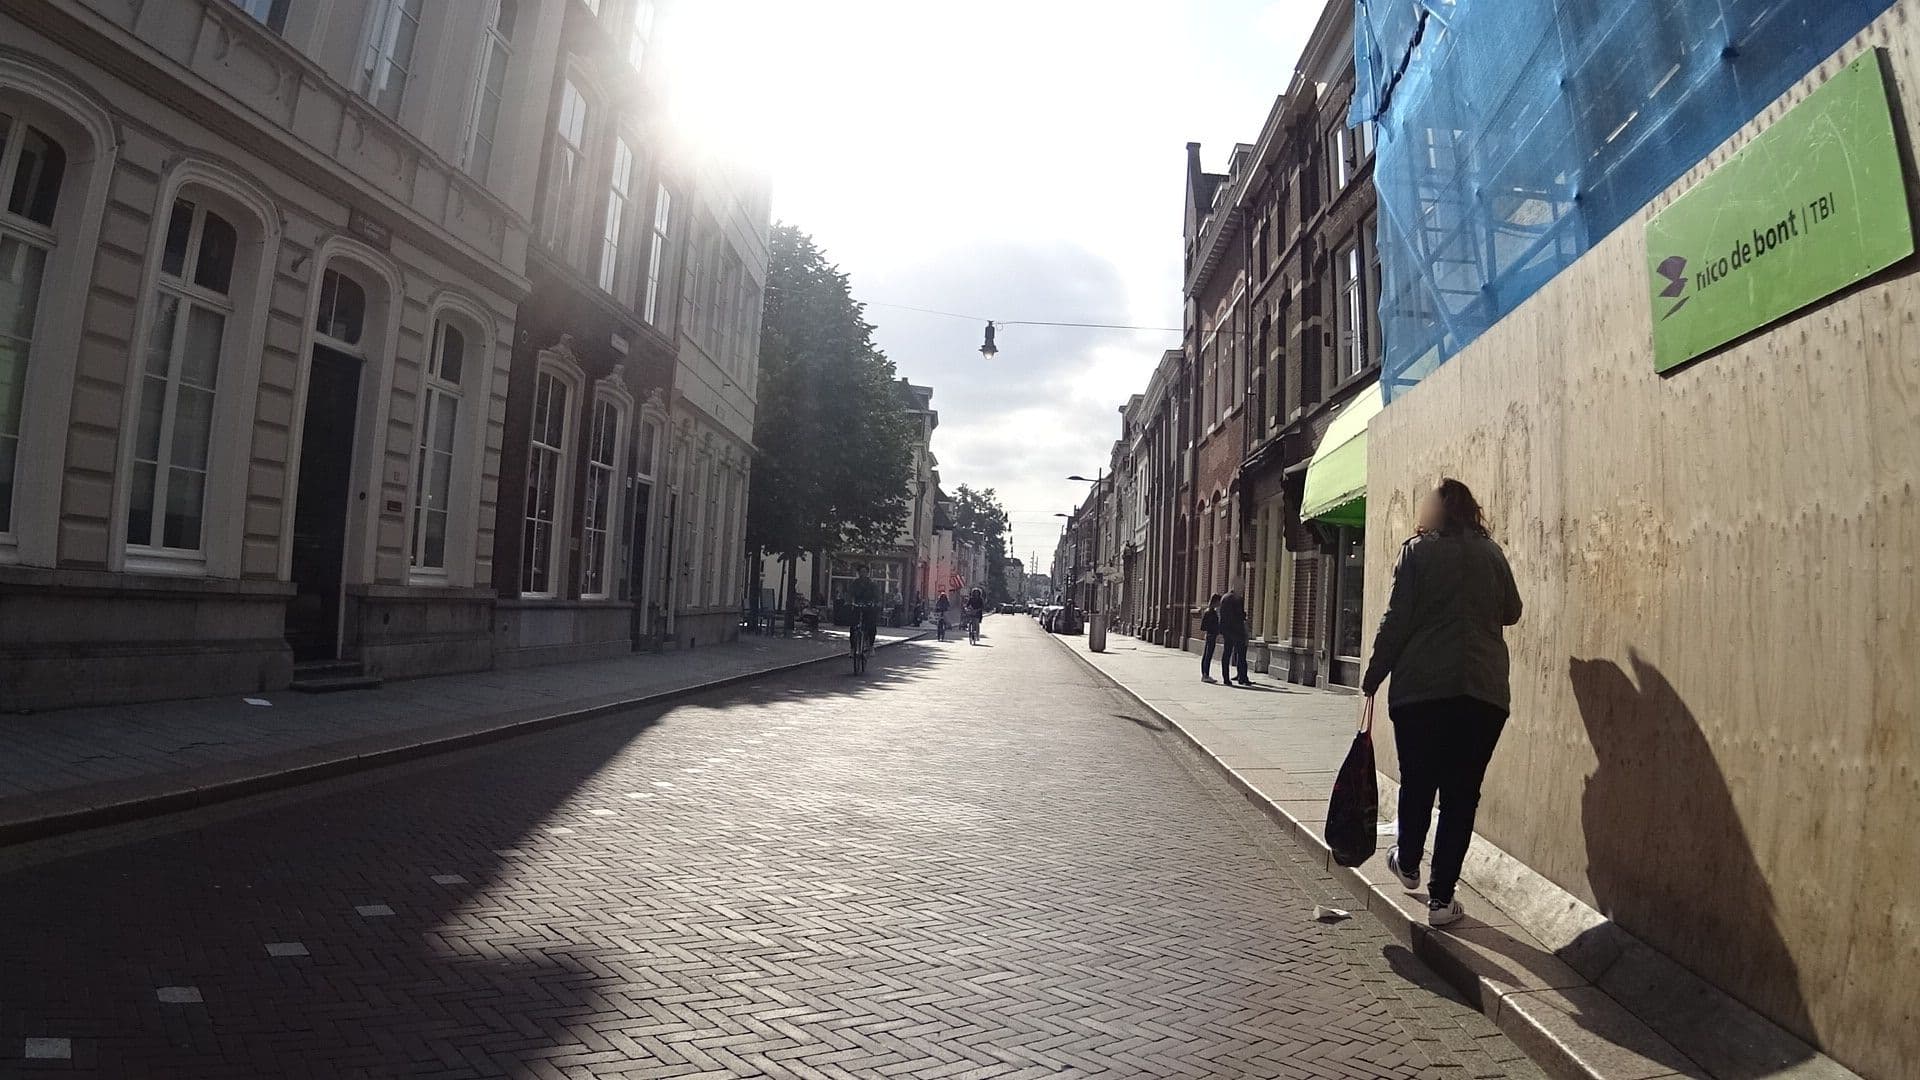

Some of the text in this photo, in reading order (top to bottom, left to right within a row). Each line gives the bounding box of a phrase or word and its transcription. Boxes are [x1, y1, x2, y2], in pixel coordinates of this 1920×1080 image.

[1696, 192, 1835, 291] nico de bont TBI
